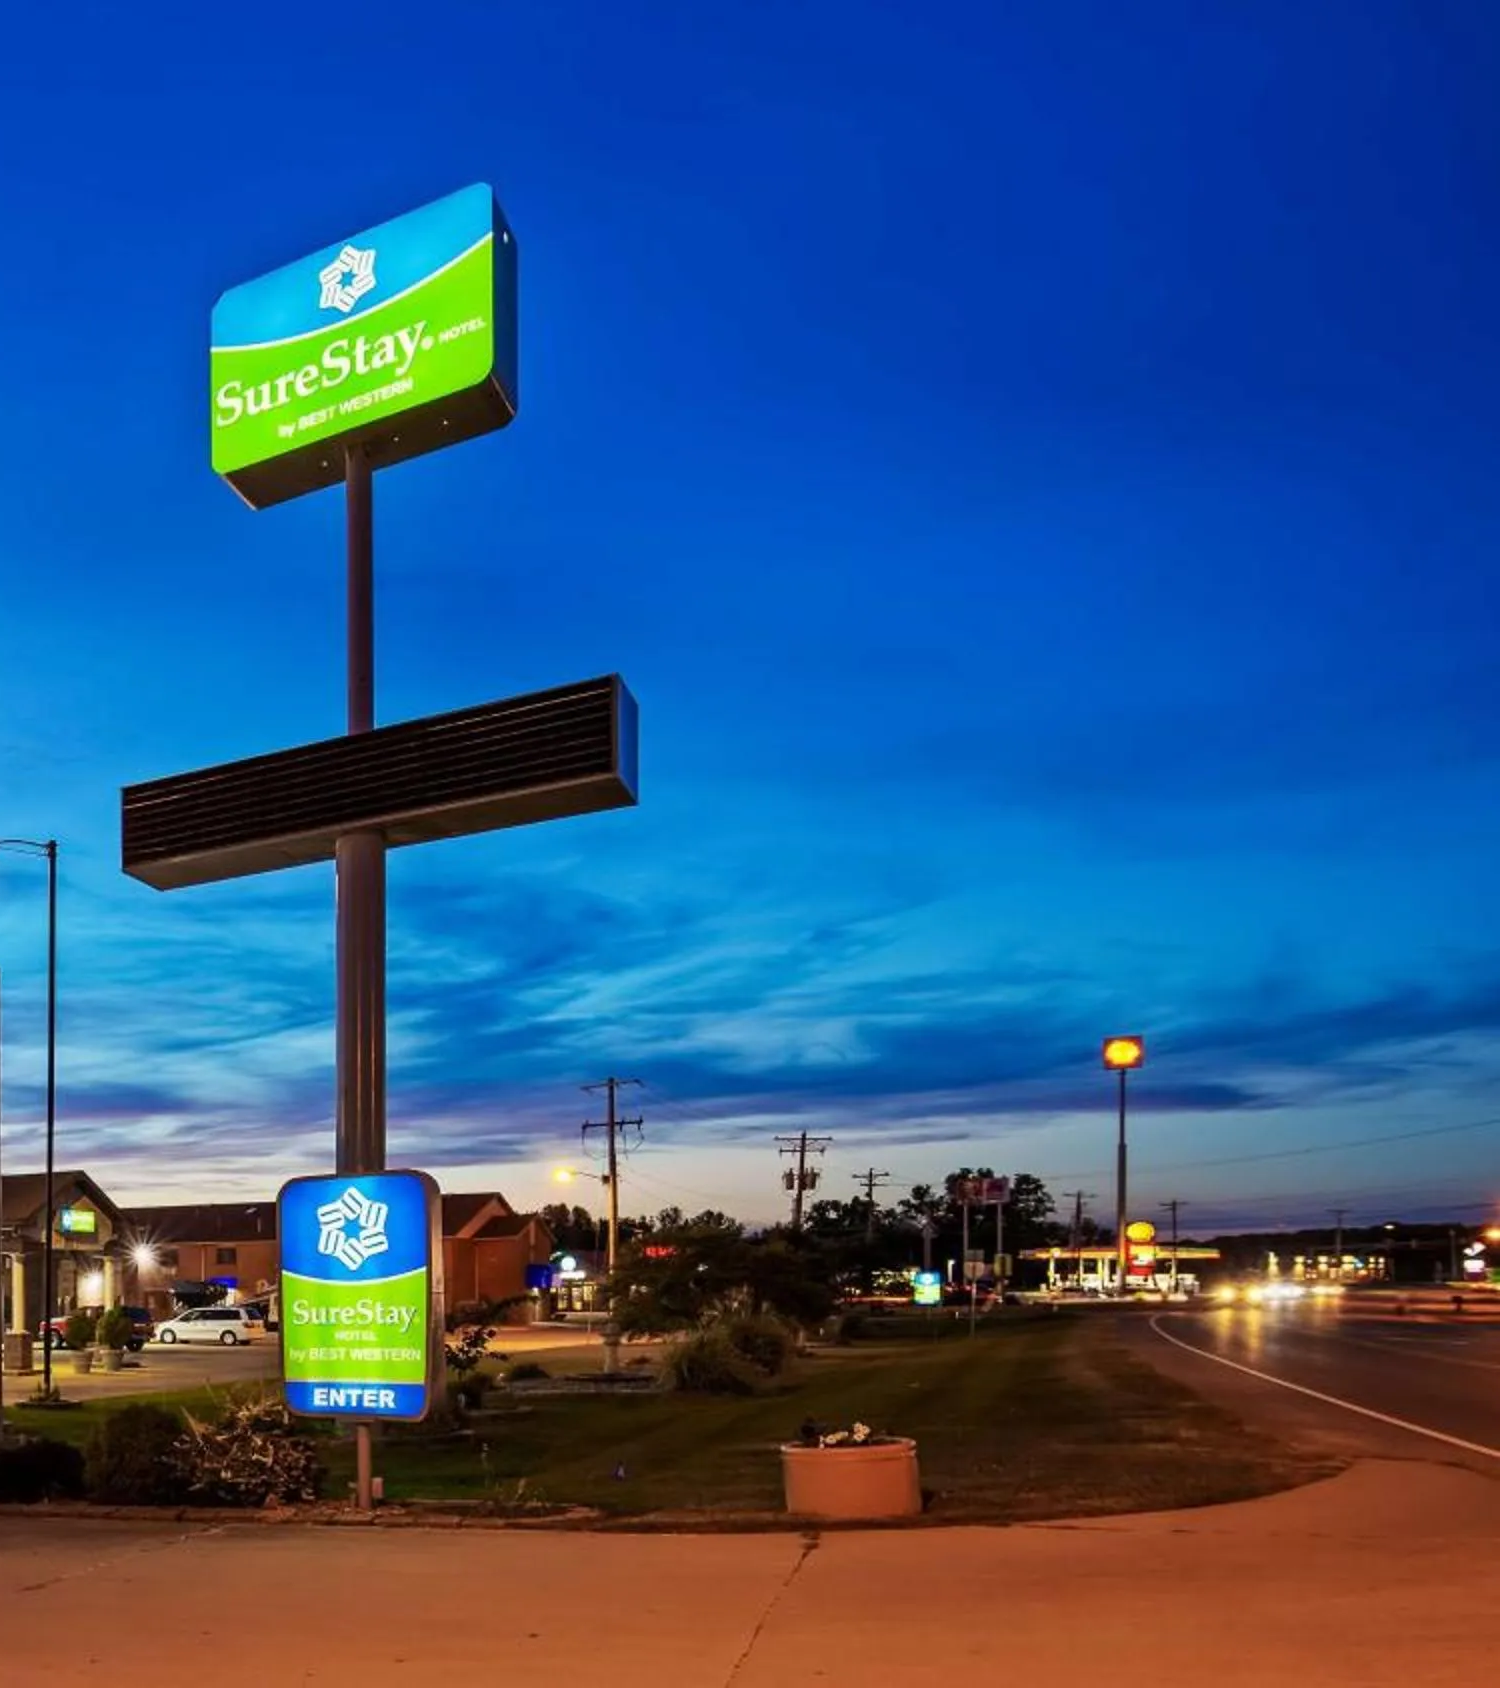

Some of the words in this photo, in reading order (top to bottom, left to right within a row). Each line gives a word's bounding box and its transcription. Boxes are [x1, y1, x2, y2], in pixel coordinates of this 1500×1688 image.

[215, 320, 426, 426] SureStay
[439, 317, 486, 345] HOTEL
[277, 421, 296, 438] by
[298, 405, 337, 430] BEST
[339, 378, 414, 415] WESTERN
[292, 1299, 416, 1333] SureStay
[289, 1347, 306, 1362] by
[308, 1347, 346, 1361] BEST
[349, 1347, 421, 1361] WESTERN
[313, 1388, 396, 1408] ENTER
